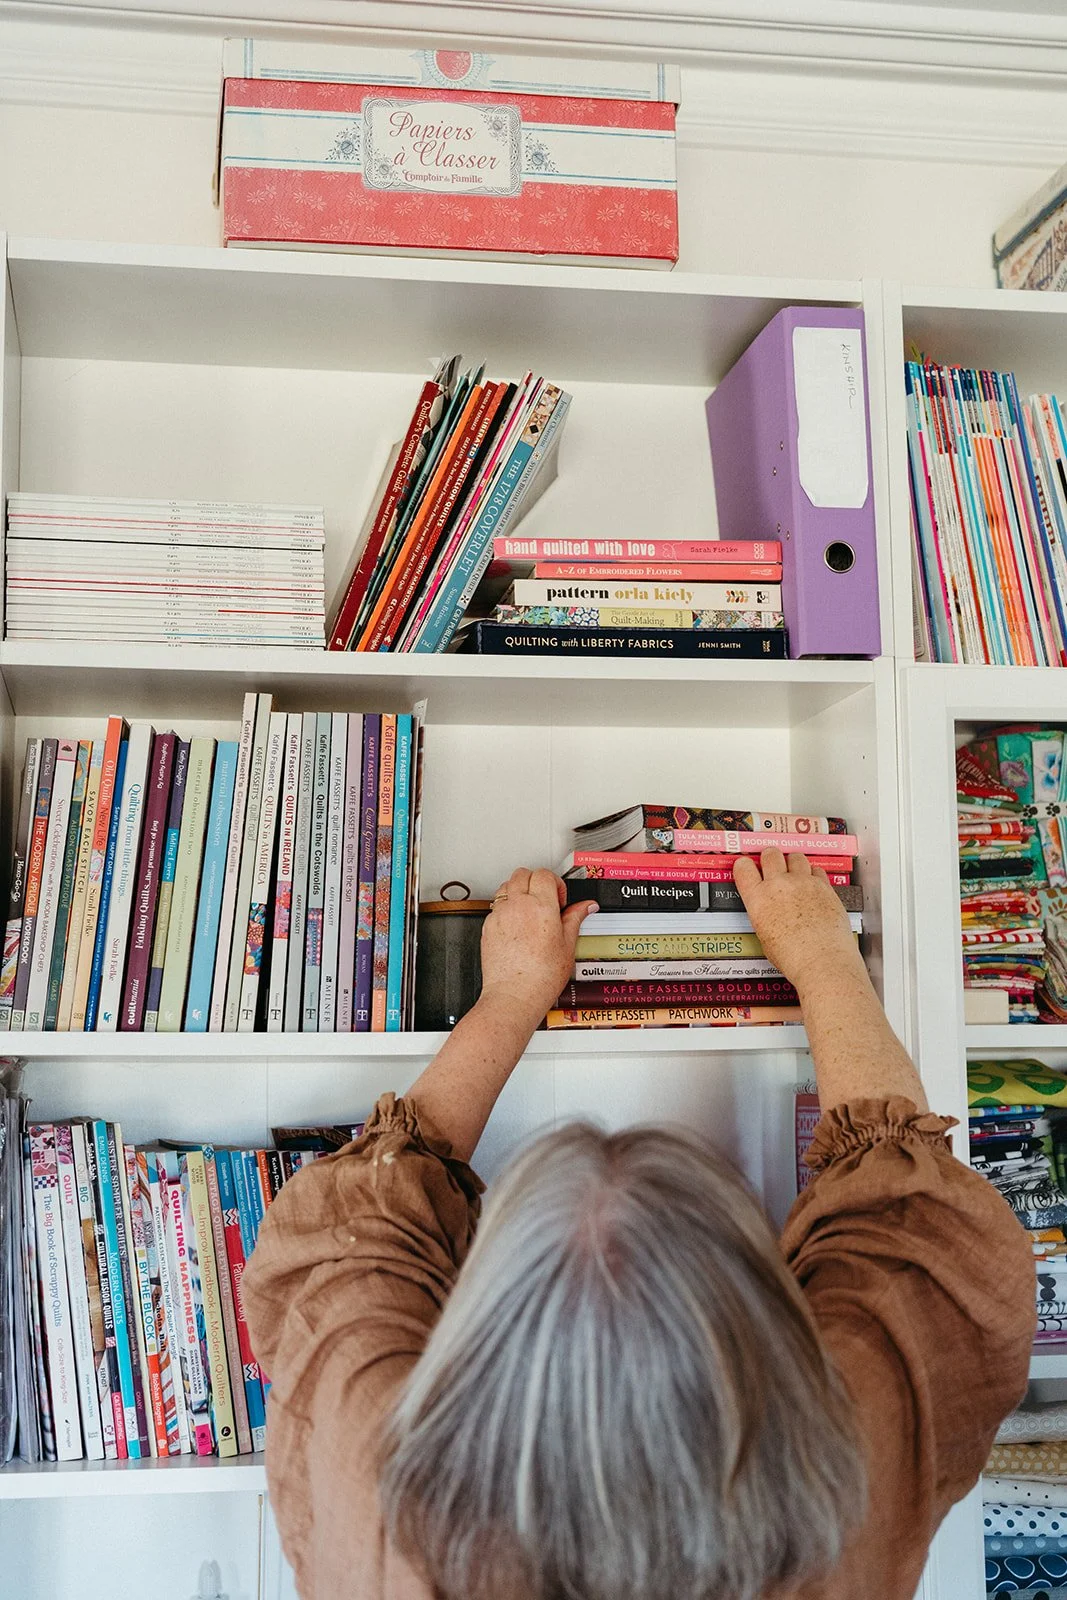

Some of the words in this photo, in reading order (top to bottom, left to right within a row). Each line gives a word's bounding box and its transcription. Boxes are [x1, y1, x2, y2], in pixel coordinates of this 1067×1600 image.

[389, 111, 476, 144] Papiers
[393, 147, 407, 166] à
[413, 140, 500, 170] Classer
[402, 170, 444, 182] Comptoir
[451, 174, 482, 183] Famille
[841, 342, 856, 398] KINSHIP
[468, 417, 490, 456] LIBERATED
[448, 457, 471, 500] MEDALLION
[506, 458, 521, 479] THE
[492, 480, 511, 505] 1718
[436, 500, 452, 527] QUILTS
[457, 504, 499, 575] COVERLET
[505, 540, 537, 554] hand
[544, 541, 588, 555] quilted
[595, 541, 622, 556] with
[628, 542, 655, 556] love
[415, 555, 427, 574] GWEN
[444, 586, 457, 605] Susan
[547, 587, 609, 601] pattern
[615, 587, 648, 600] orla
[655, 588, 695, 604] kiely
[432, 604, 448, 628] Briscoe
[611, 616, 664, 626] Quilt-Making
[505, 637, 558, 647] QUILTING
[562, 638, 578, 647] with
[581, 639, 625, 647] LIBERTY
[628, 640, 674, 648] FABRICS
[242, 719, 250, 743] Kaffe
[384, 725, 394, 750] Kaffe
[44, 745, 52, 763] Jenifer
[160, 742, 168, 764] Doughty
[271, 733, 279, 754] Kaffe
[104, 760, 114, 777] Old
[178, 749, 186, 764] Kathy
[237, 746, 247, 787] Fassett's
[382, 754, 393, 783] quilts
[175, 764, 184, 786] Doughty
[251, 767, 260, 799] FASSETT'S
[267, 756, 277, 791] Fassett's
[99, 778, 111, 804] Quilts
[381, 787, 391, 814] again
[86, 790, 95, 822] SAVOR
[98, 807, 108, 826] New
[233, 790, 242, 830] Caravan
[247, 804, 258, 820] quilt
[262, 795, 273, 829] QUILTS
[315, 794, 324, 818] Quilts
[366, 807, 374, 829] Quilt
[247, 823, 256, 840] road
[330, 814, 339, 830] quilt
[82, 828, 90, 853] EACH
[95, 829, 106, 845] Life
[167, 831, 176, 856] Adding
[232, 833, 238, 842] of
[262, 831, 269, 839] in
[727, 832, 738, 849] 100
[781, 839, 804, 847] QUILT
[807, 840, 838, 848] BLOCKS
[228, 846, 237, 872] Quilts
[345, 843, 354, 864] quilts
[362, 830, 373, 870] Grandeur
[164, 857, 173, 880] Layers
[257, 842, 269, 885] AMERICA
[312, 849, 321, 895] Cotswolds
[12, 860, 24, 902] Hexa-Go-Go
[77, 859, 86, 893] STITCH
[621, 886, 648, 898] Quilt
[651, 886, 694, 899] Recipes
[618, 943, 659, 954] SHOTS
[664, 944, 688, 954] AND
[692, 942, 742, 953] STRIPES
[581, 1010, 612, 1021] KAFFE
[616, 1010, 656, 1020] FASSETT
[669, 1008, 733, 1020] PATCHWORK
[107, 1140, 117, 1171] SISTER
[63, 1174, 72, 1205] QUILT
[111, 1175, 122, 1219] SAMPLER
[206, 1167, 219, 1212] VINTAGE
[43, 1194, 52, 1210] The
[43, 1212, 53, 1226] Big
[212, 1215, 223, 1246] QUILT
[46, 1228, 55, 1250] Book
[116, 1222, 126, 1256] QUILTS
[48, 1251, 56, 1260] of
[96, 1241, 107, 1276] CULTURAL
[170, 1190, 186, 1256] QUILTING
[178, 1261, 196, 1343] HAPPINESS
[47, 1262, 59, 1297] Scrappy
[138, 1262, 147, 1277] BY
[217, 1248, 230, 1296] REVIVAL
[100, 1278, 110, 1302] FUSION
[140, 1279, 149, 1298] THE
[52, 1299, 62, 1326] Quilts
[103, 1305, 113, 1329] QUILTS
[143, 1302, 154, 1339] BLOCK
[154, 1292, 163, 1330] Nicholas
[59, 1375, 68, 1403] King-Size
[152, 1373, 160, 1400] Siobhan
[115, 1408, 123, 1439] PUBLISHING
[153, 1402, 162, 1425] Rogers
